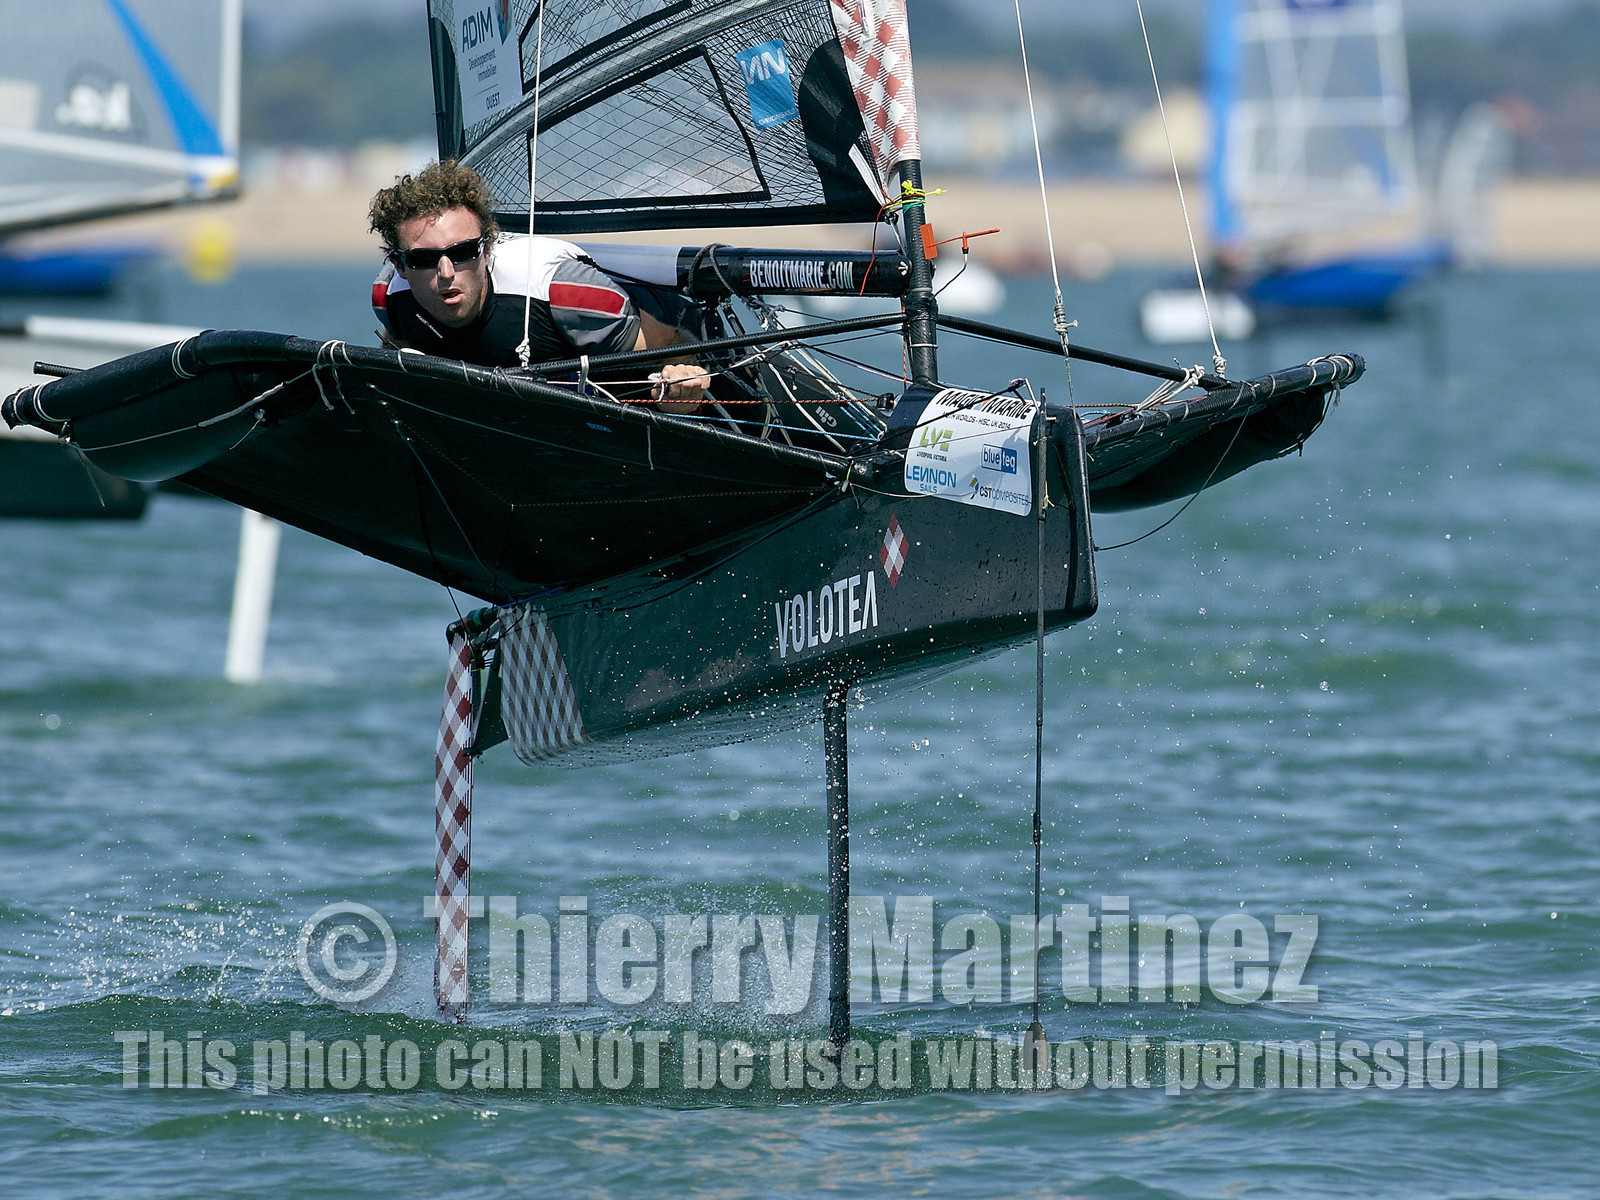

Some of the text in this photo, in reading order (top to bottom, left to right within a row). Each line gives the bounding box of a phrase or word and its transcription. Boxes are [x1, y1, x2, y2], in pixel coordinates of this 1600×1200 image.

[462, 6, 493, 53] ADIM
[749, 259, 855, 291] BENOITMARIE.COM
[981, 397, 1034, 420] MARINE
[919, 483, 938, 494] SAILS
